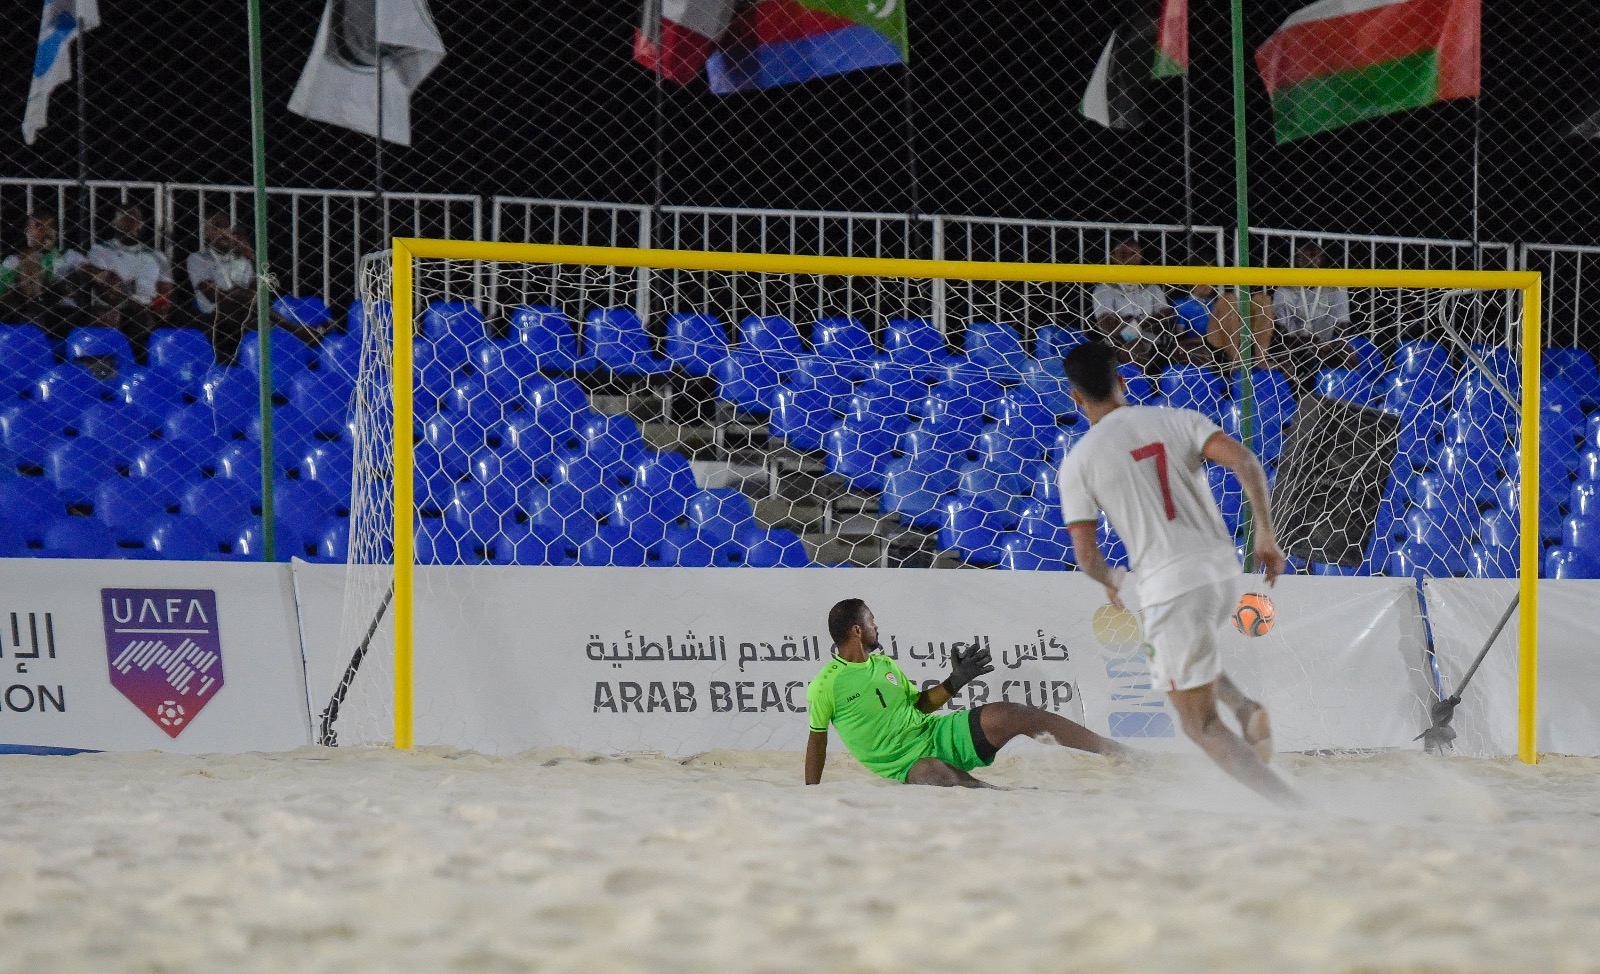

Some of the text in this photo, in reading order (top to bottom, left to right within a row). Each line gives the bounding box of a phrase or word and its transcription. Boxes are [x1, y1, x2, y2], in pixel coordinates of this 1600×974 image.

[1130, 442, 1176, 521] 7
[111, 598, 208, 623] UAFA
[586, 630, 727, 668] الشاطئية
[739, 635, 820, 672] القدم
[1002, 629, 1069, 669] كأس
[0, 684, 65, 712] ON
[593, 681, 697, 713] ARAB
[709, 681, 812, 713] BEAC
[1001, 680, 1073, 711] CUP
[875, 688, 887, 709] 1
